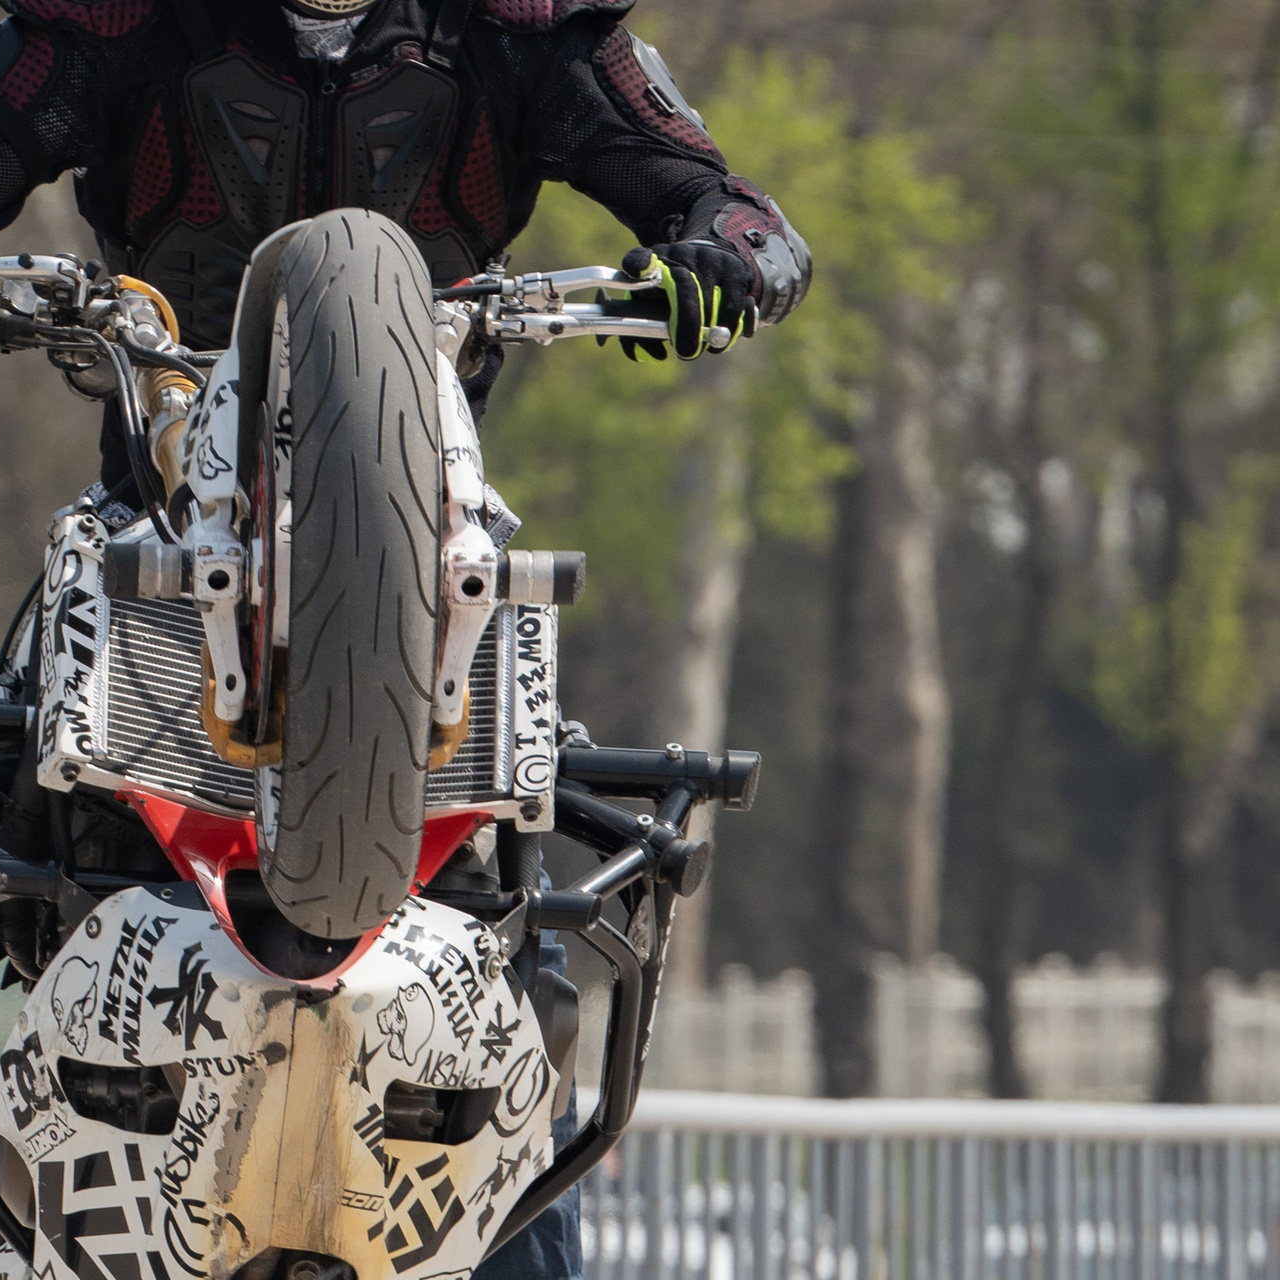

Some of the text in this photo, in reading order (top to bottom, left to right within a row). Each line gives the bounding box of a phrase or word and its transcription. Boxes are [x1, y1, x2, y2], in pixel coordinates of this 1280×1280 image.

[516, 604, 542, 663] MOT
[98, 914, 147, 1045] METAL
[182, 1052, 258, 1078] STUN
